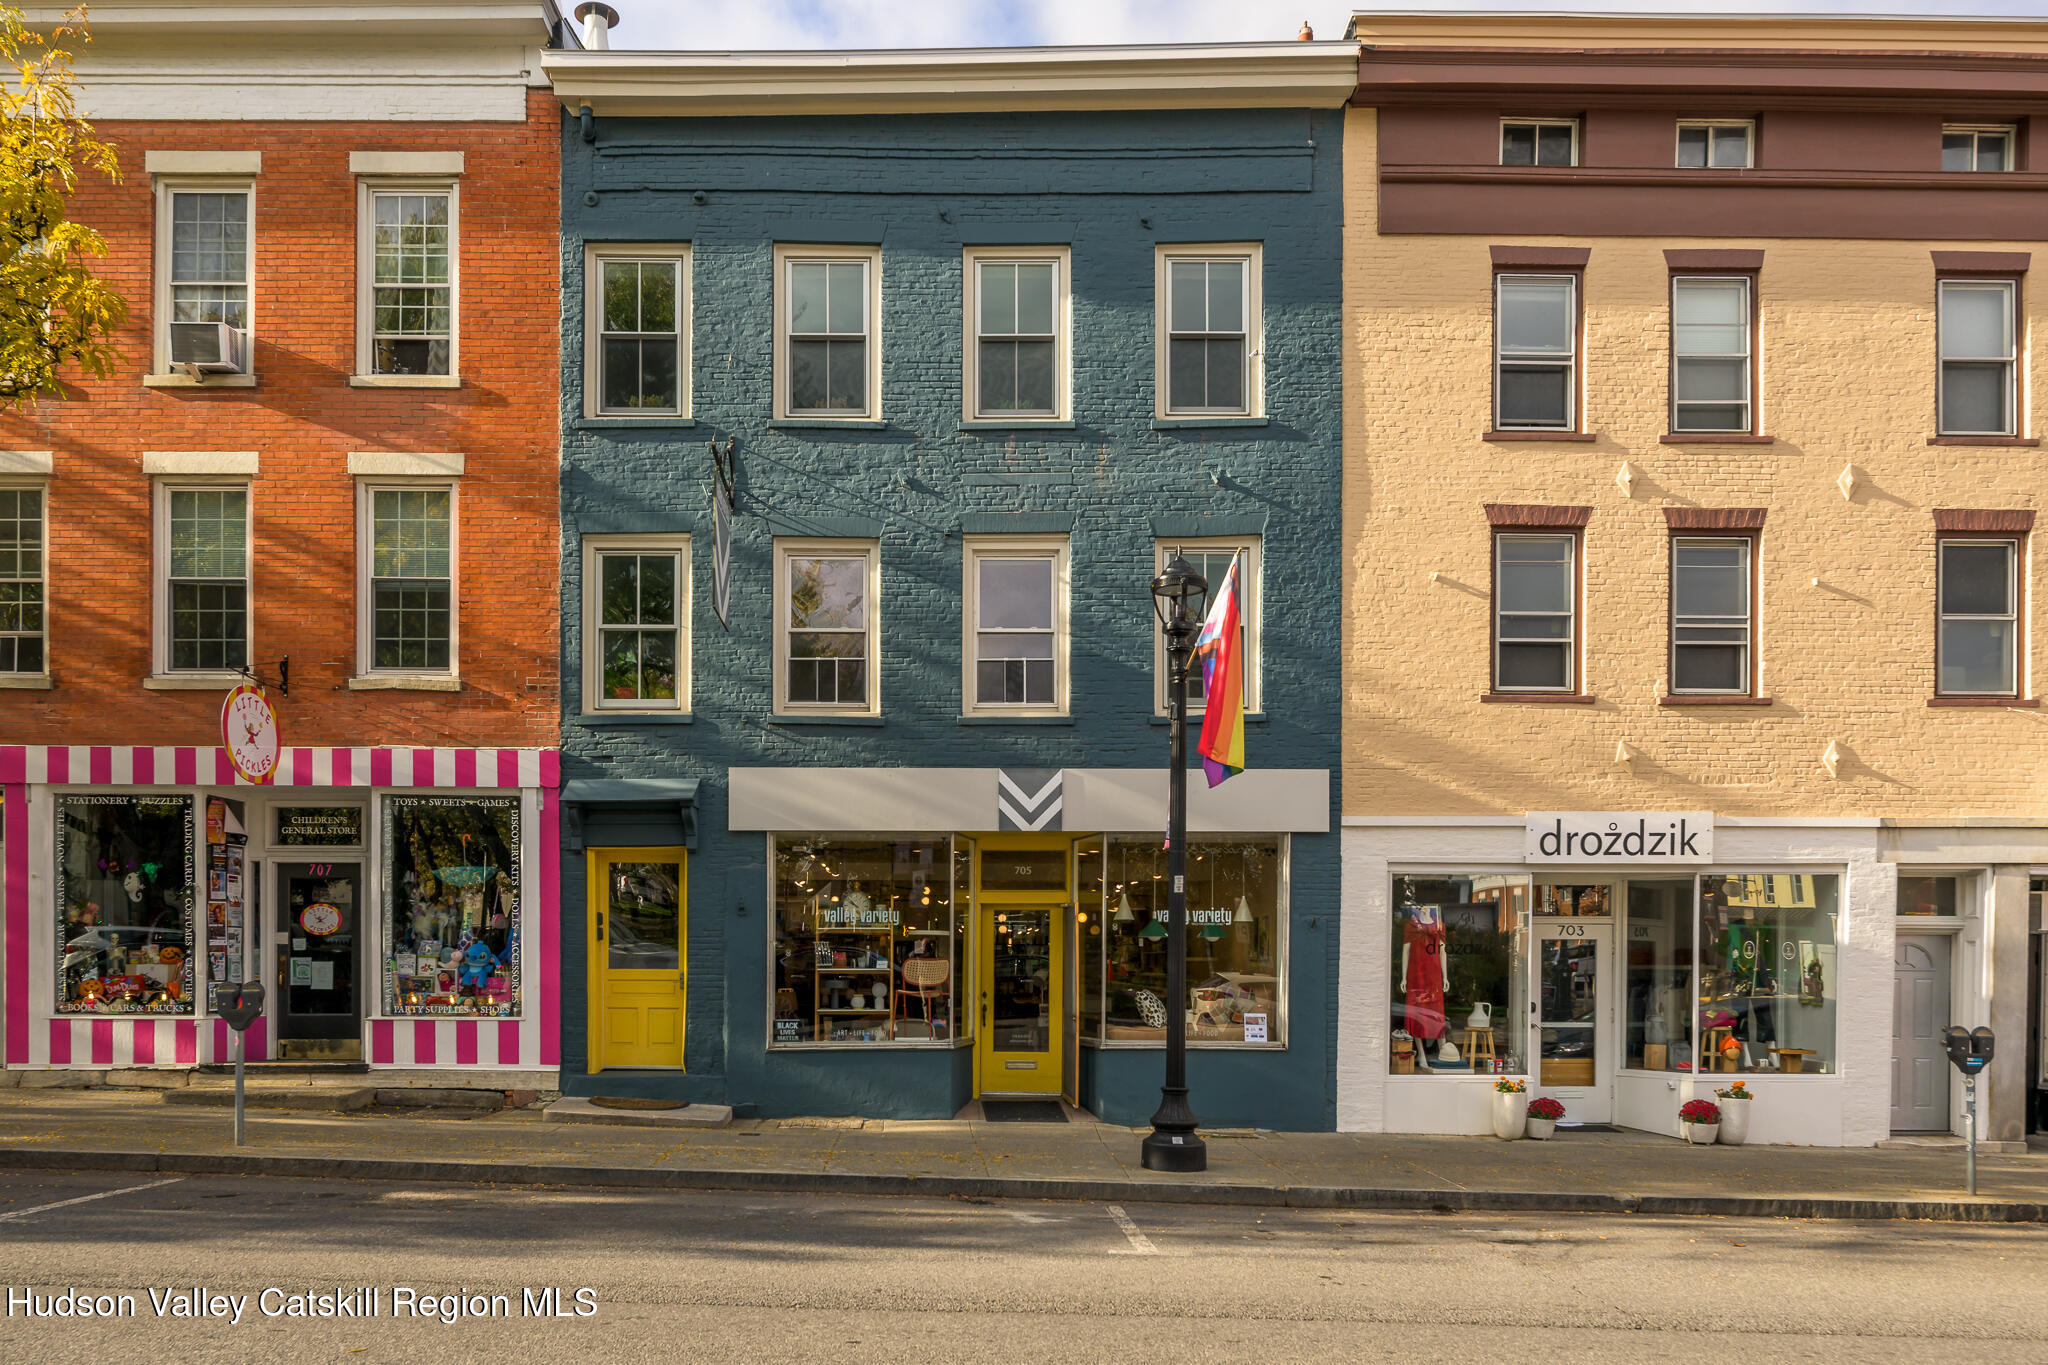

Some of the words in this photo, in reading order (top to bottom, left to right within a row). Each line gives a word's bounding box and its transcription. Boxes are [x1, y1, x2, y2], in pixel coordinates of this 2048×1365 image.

[235, 697, 271, 724] LITTLE
[235, 748, 272, 773] PICKLES
[66, 796, 129, 805] STATIONERY
[142, 797, 184, 805] PUZZLES
[393, 798, 418, 806] TOYS
[428, 798, 466, 807] SWEETS
[476, 799, 510, 807] GAMES
[184, 808, 193, 854] TRADING
[291, 816, 348, 824] CHILDREN'S
[384, 809, 392, 847] CRAFTS
[57, 807, 65, 863] NOVELTIES
[511, 809, 520, 862] DISCOVERY
[184, 855, 193, 887] CARDS
[309, 863, 333, 876] 707
[384, 858, 392, 884] ARTS
[511, 864, 520, 886] KITS
[1014, 866, 1032, 875] 705
[57, 874, 65, 911] TRAINS
[184, 897, 193, 946] COSTUMES
[384, 895, 392, 946] BALLOONS
[511, 897, 520, 929] DOLLS
[824, 906, 857, 925] valley
[860, 907, 900, 925] variety
[1191, 907, 1232, 926] variety
[57, 924, 65, 950] GEAR
[1557, 925, 1585, 937] 703
[57, 952, 65, 1001] SEASONAL
[184, 957, 193, 1002] CLOTHES
[384, 958, 392, 1002] MARBLES
[511, 940, 520, 1003] ACCESSORIES
[67, 1004, 97, 1013] BOOKS
[110, 1004, 134, 1013] CARS
[135, 1004, 144, 1013] &
[145, 1004, 184, 1013] TRUCKS
[393, 1005, 423, 1014] PARTY
[425, 1005, 469, 1014] SUPPLIES
[479, 1005, 510, 1014] SHOES
[777, 1021, 799, 1029] BLACK
